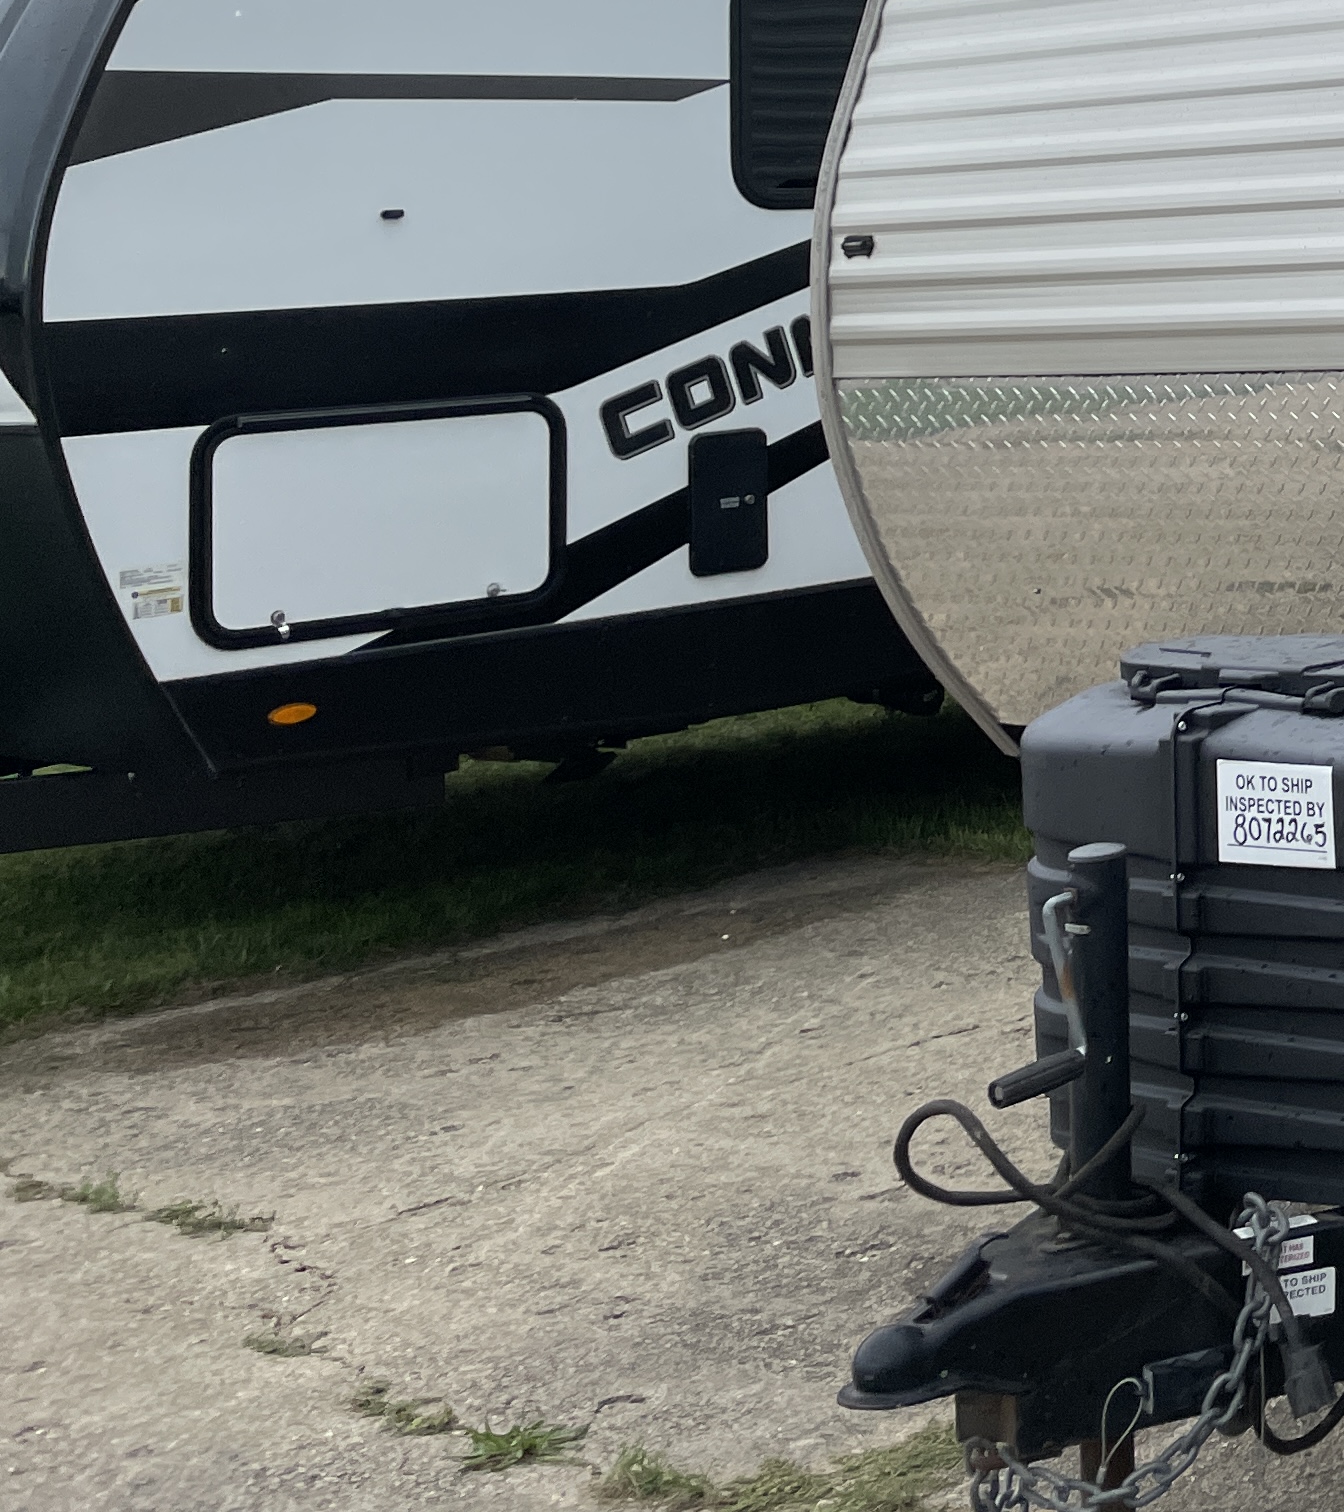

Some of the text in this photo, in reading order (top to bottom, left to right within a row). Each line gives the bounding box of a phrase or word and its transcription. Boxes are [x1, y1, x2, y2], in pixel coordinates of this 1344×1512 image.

[1235, 774, 1313, 794] OK TO SHIP
[1225, 795, 1325, 818] INSPECTED BY
[1233, 813, 1327, 848] 8072265
[1283, 1272, 1327, 1289] TO SHIP
